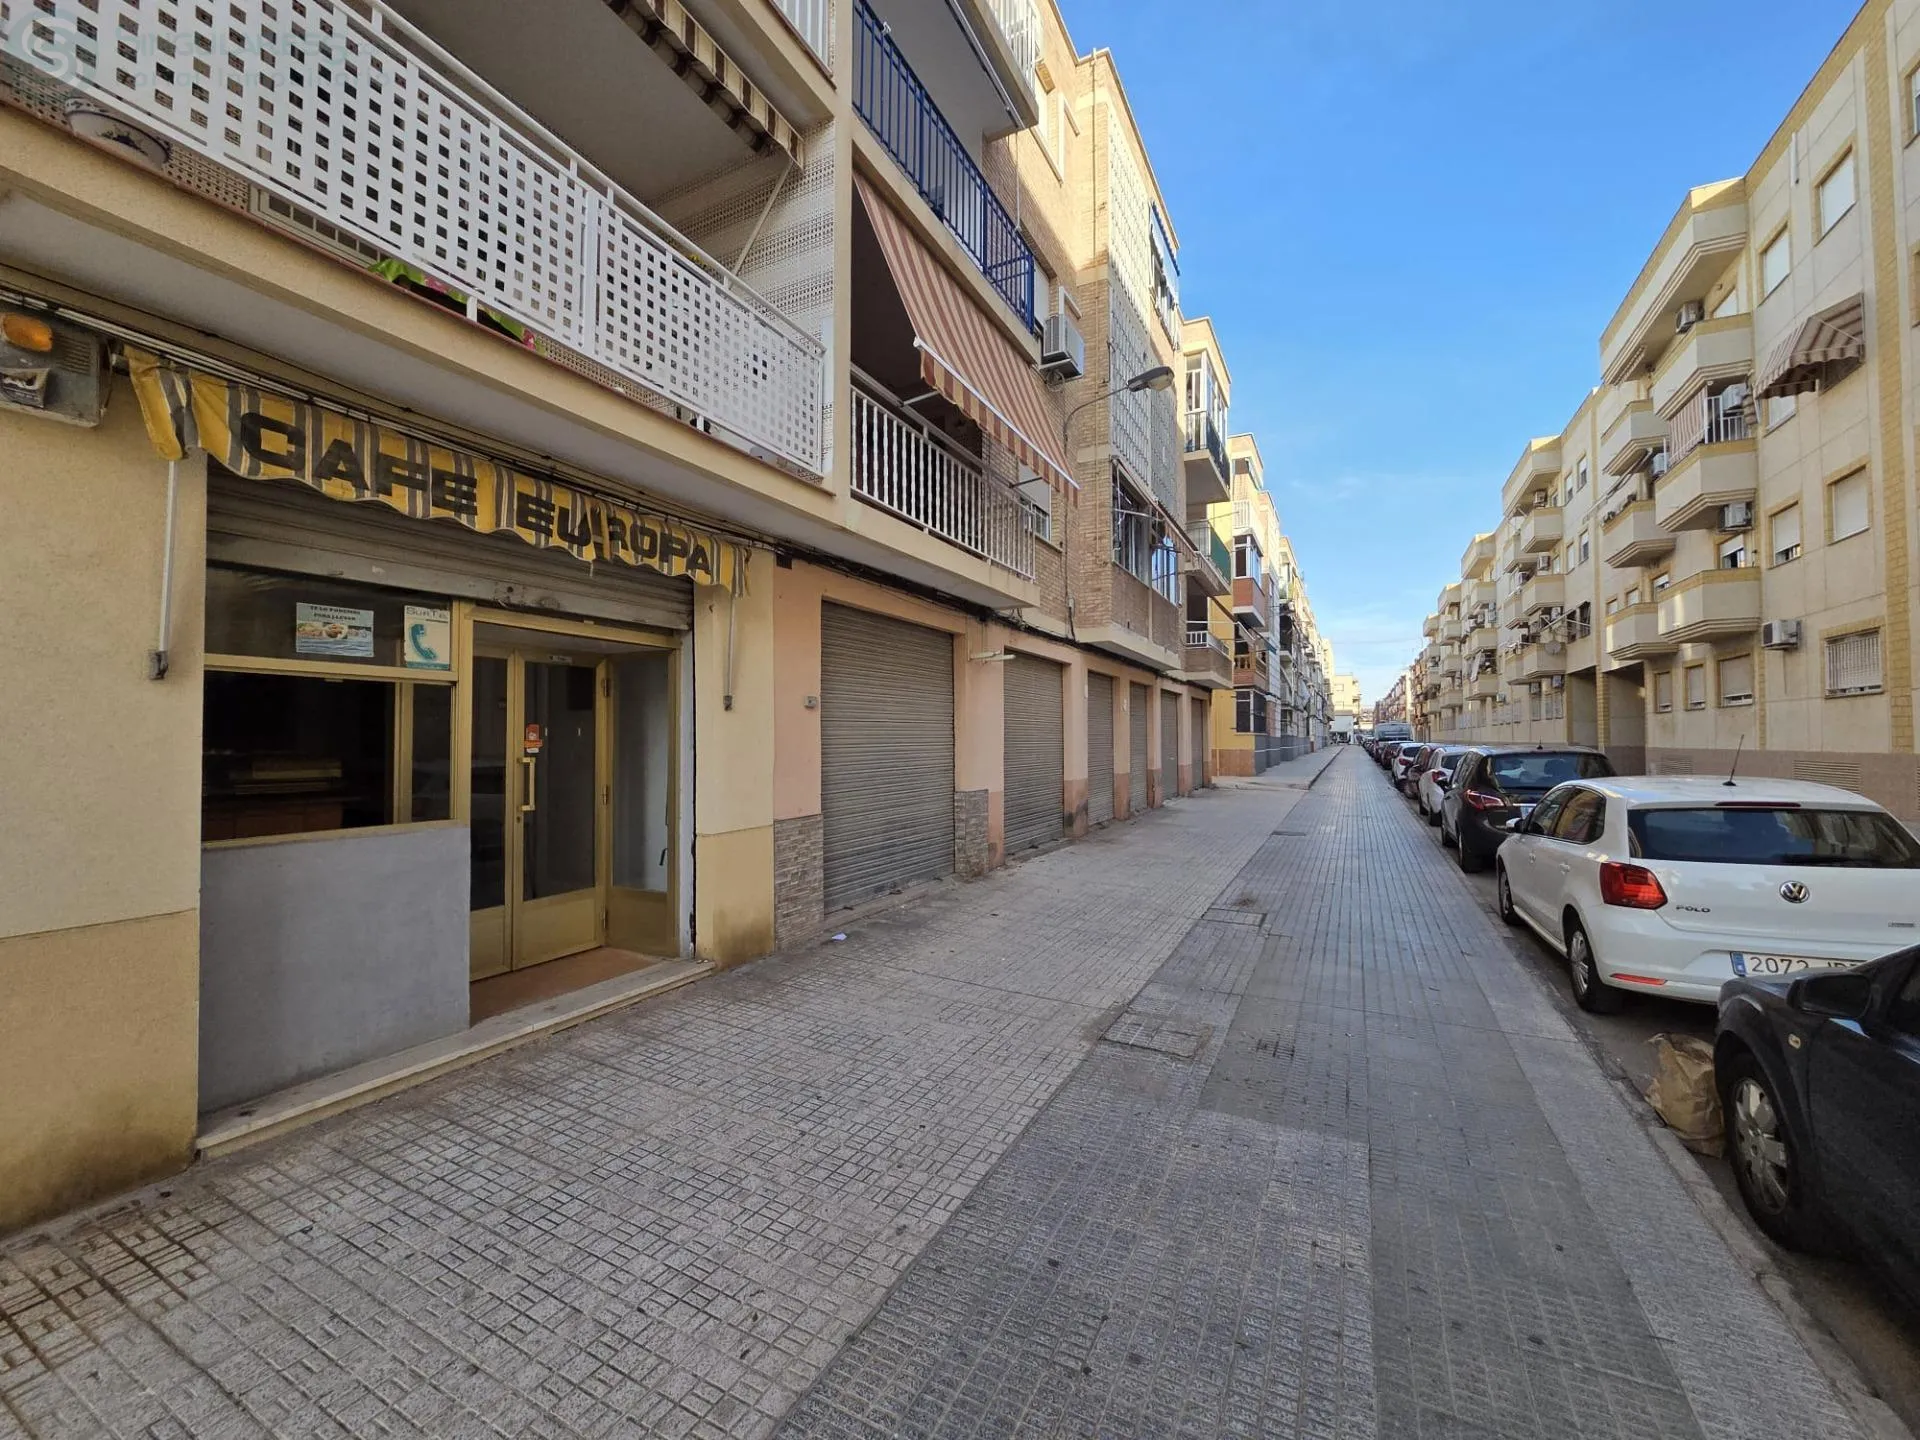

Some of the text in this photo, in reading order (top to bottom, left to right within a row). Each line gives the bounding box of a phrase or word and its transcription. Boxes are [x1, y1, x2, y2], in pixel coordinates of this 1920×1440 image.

[240, 411, 712, 576] CAFE EUROPA
[1675, 904, 1711, 913] POLO
